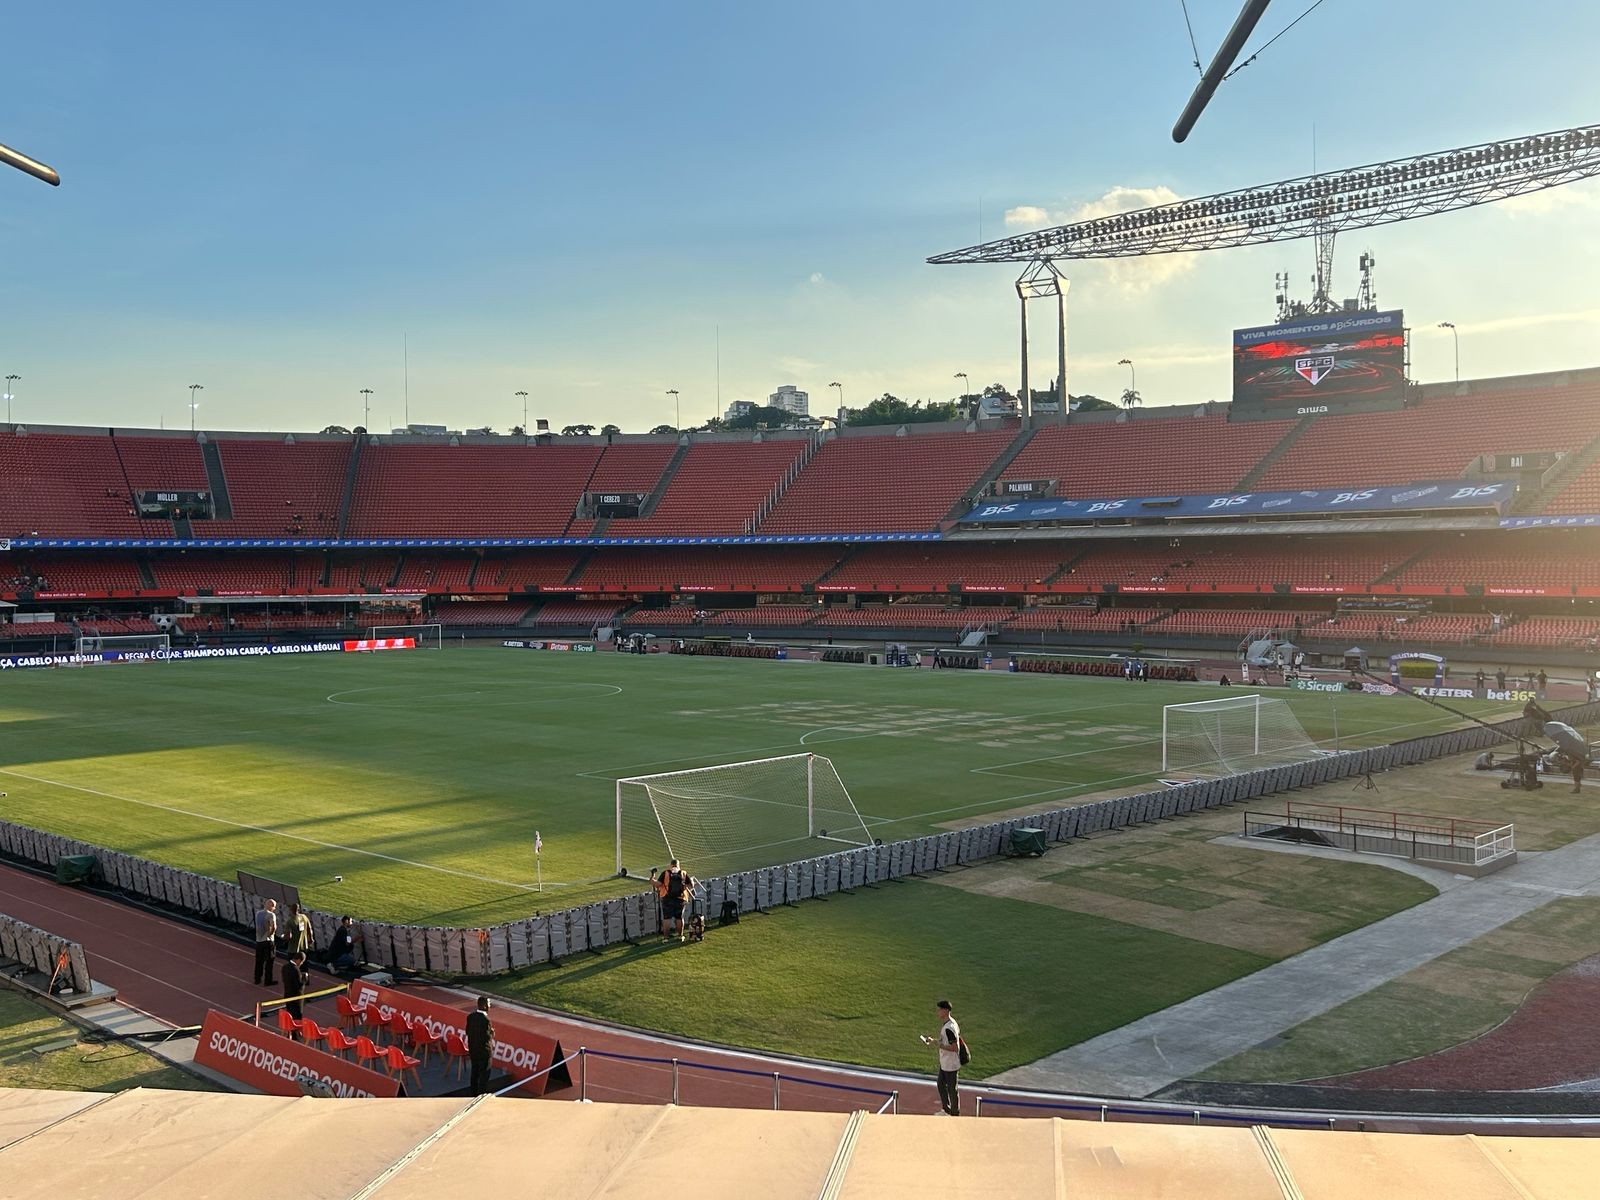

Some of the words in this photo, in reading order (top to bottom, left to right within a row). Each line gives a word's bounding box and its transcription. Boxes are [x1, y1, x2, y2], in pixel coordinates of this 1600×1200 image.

[1242, 332, 1266, 340] VIVA
[1267, 324, 1328, 338] MOMENTOS
[1299, 358, 1331, 368] SPFC
[1297, 406, 1328, 415] aiwa
[1008, 483, 1032, 492] PALHINHA
[151, 650, 156, 660] É
[183, 648, 225, 658] SHAMPOO
[226, 647, 238, 656] NA
[240, 646, 271, 656] CABEÇA,
[272, 645, 300, 654] CABELO
[314, 642, 340, 651] RÉGUA!
[18, 656, 52, 666] CABELO
[1306, 680, 1342, 692] Sicredi
[1487, 688, 1536, 701] bet365
[458, 1028, 540, 1072] TEDOR!
